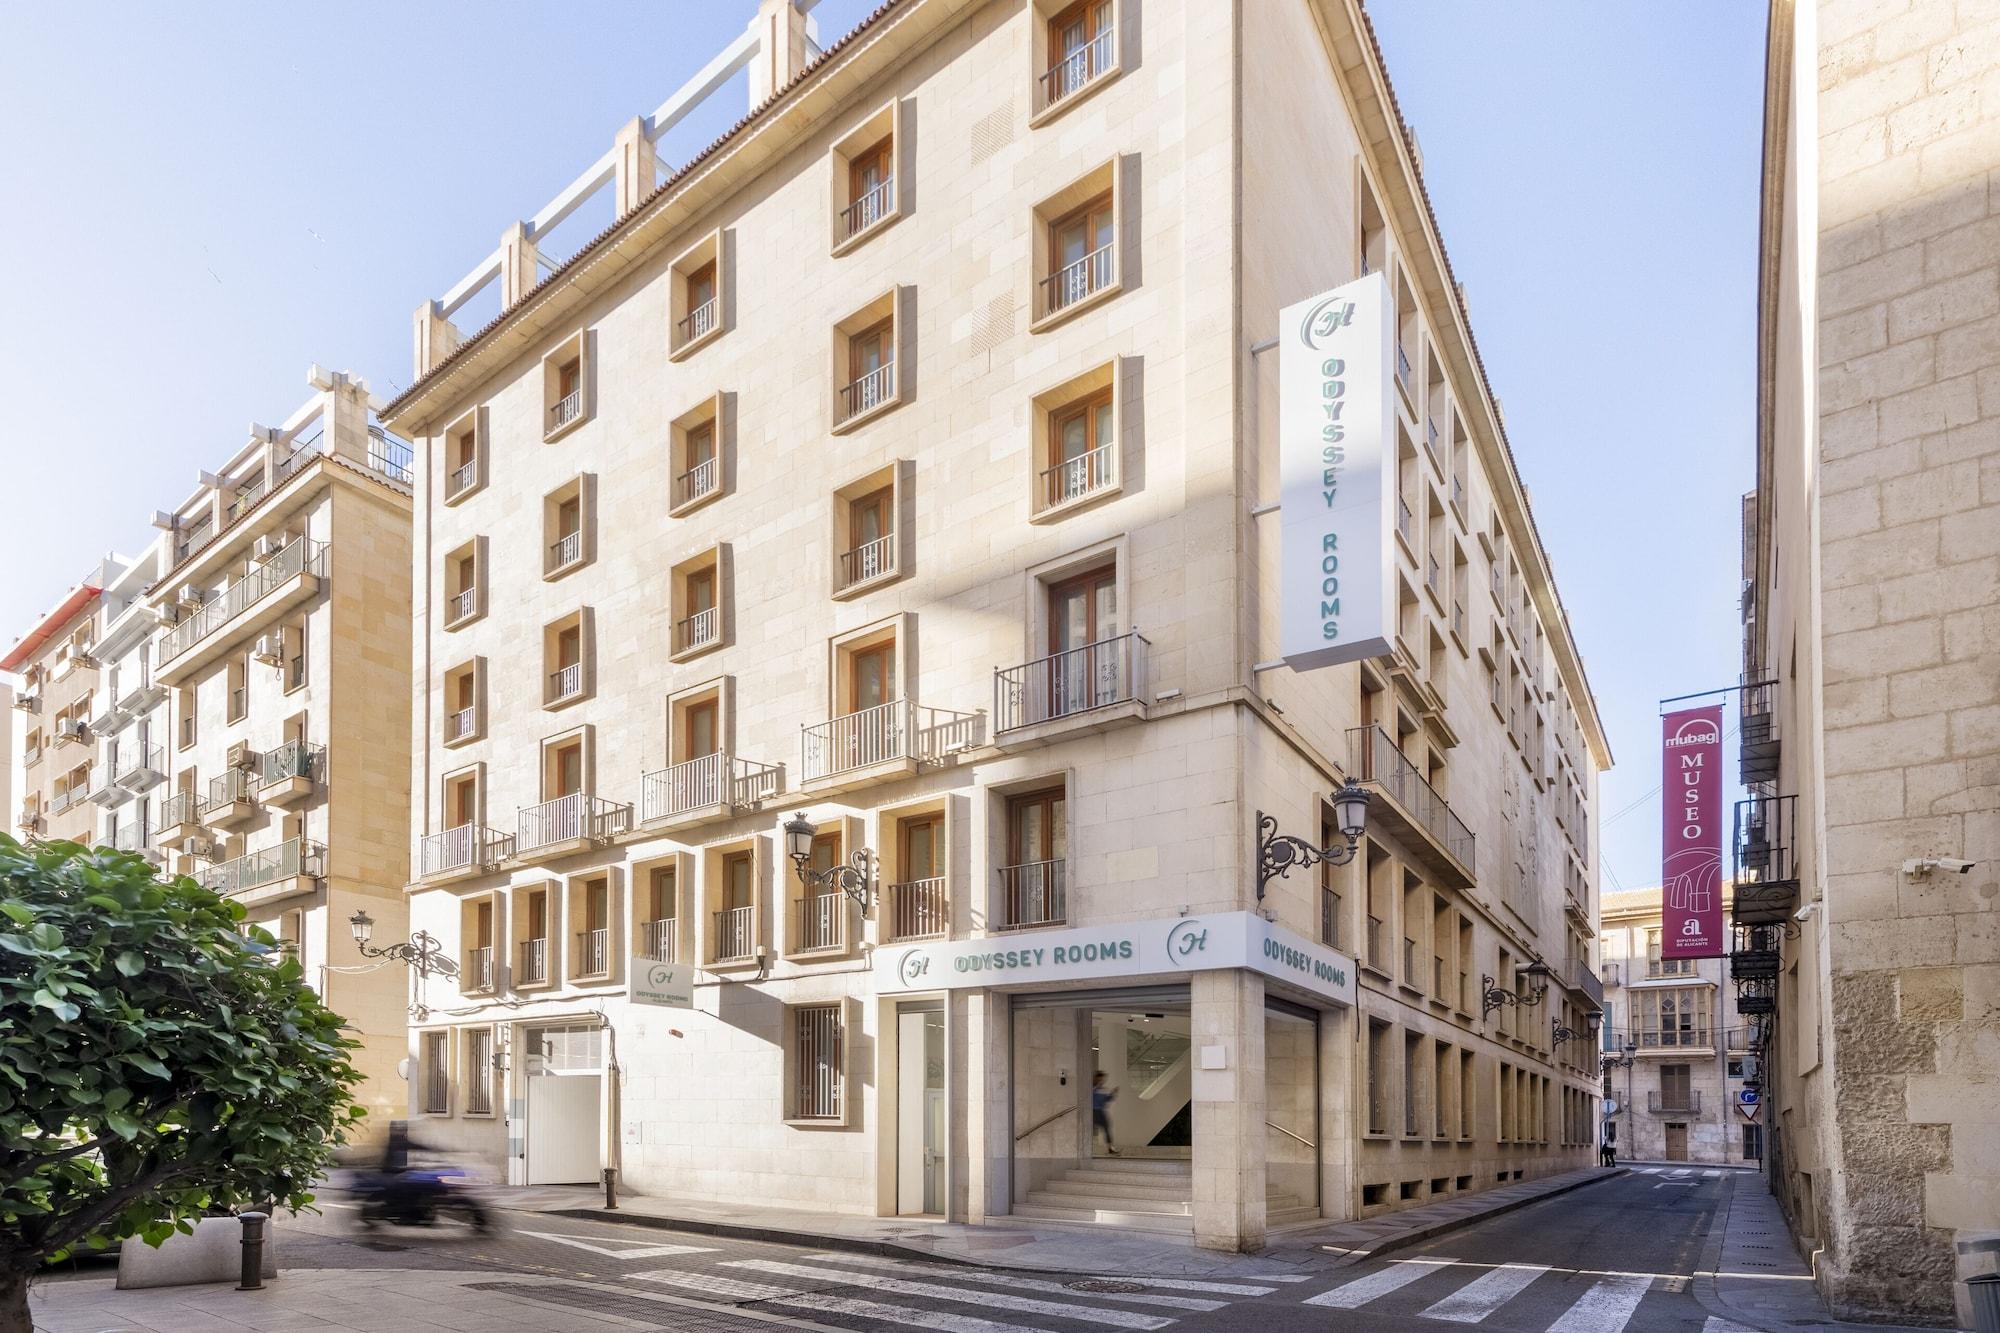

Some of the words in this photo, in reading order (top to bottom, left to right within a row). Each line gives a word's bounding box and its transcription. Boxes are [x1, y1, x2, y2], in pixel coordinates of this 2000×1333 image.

[1321, 358, 1343, 508] ODYSSEY
[1321, 532, 1340, 640] ROOMS
[1681, 752, 1704, 839] MUSEO
[954, 948, 1044, 972] ODYSSEY
[1053, 940, 1132, 965] ROOMS
[1263, 937, 1312, 973] ODYSSEY
[1314, 959, 1346, 988] ROOMS
[636, 990, 665, 999] ODYSSEY
